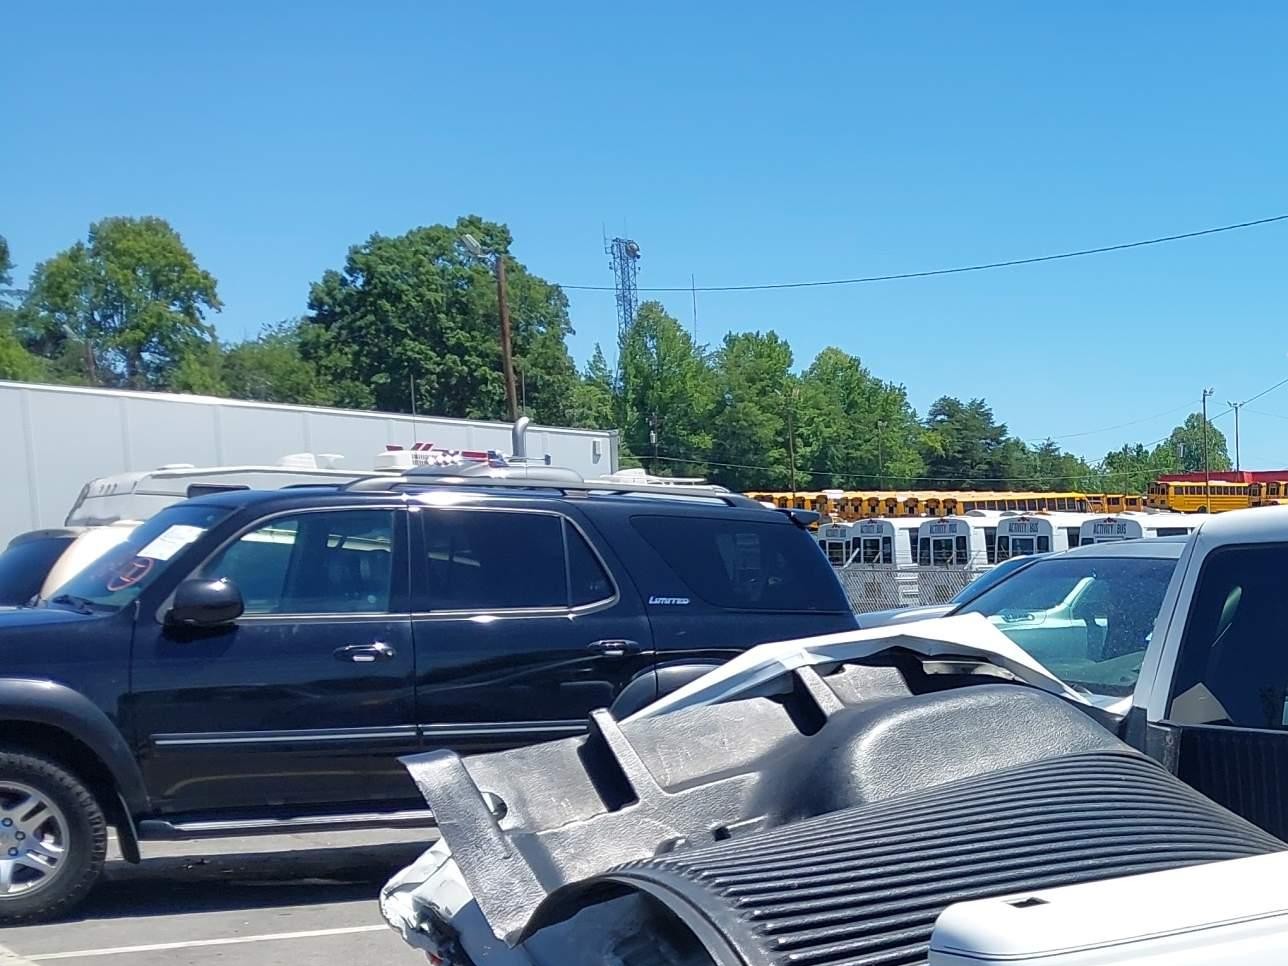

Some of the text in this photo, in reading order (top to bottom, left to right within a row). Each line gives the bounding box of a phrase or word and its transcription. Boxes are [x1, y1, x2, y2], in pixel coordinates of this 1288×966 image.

[1008, 522, 1039, 533] ACTIVITY BUS
[1093, 523, 1127, 535] ACTIVITY BUS
